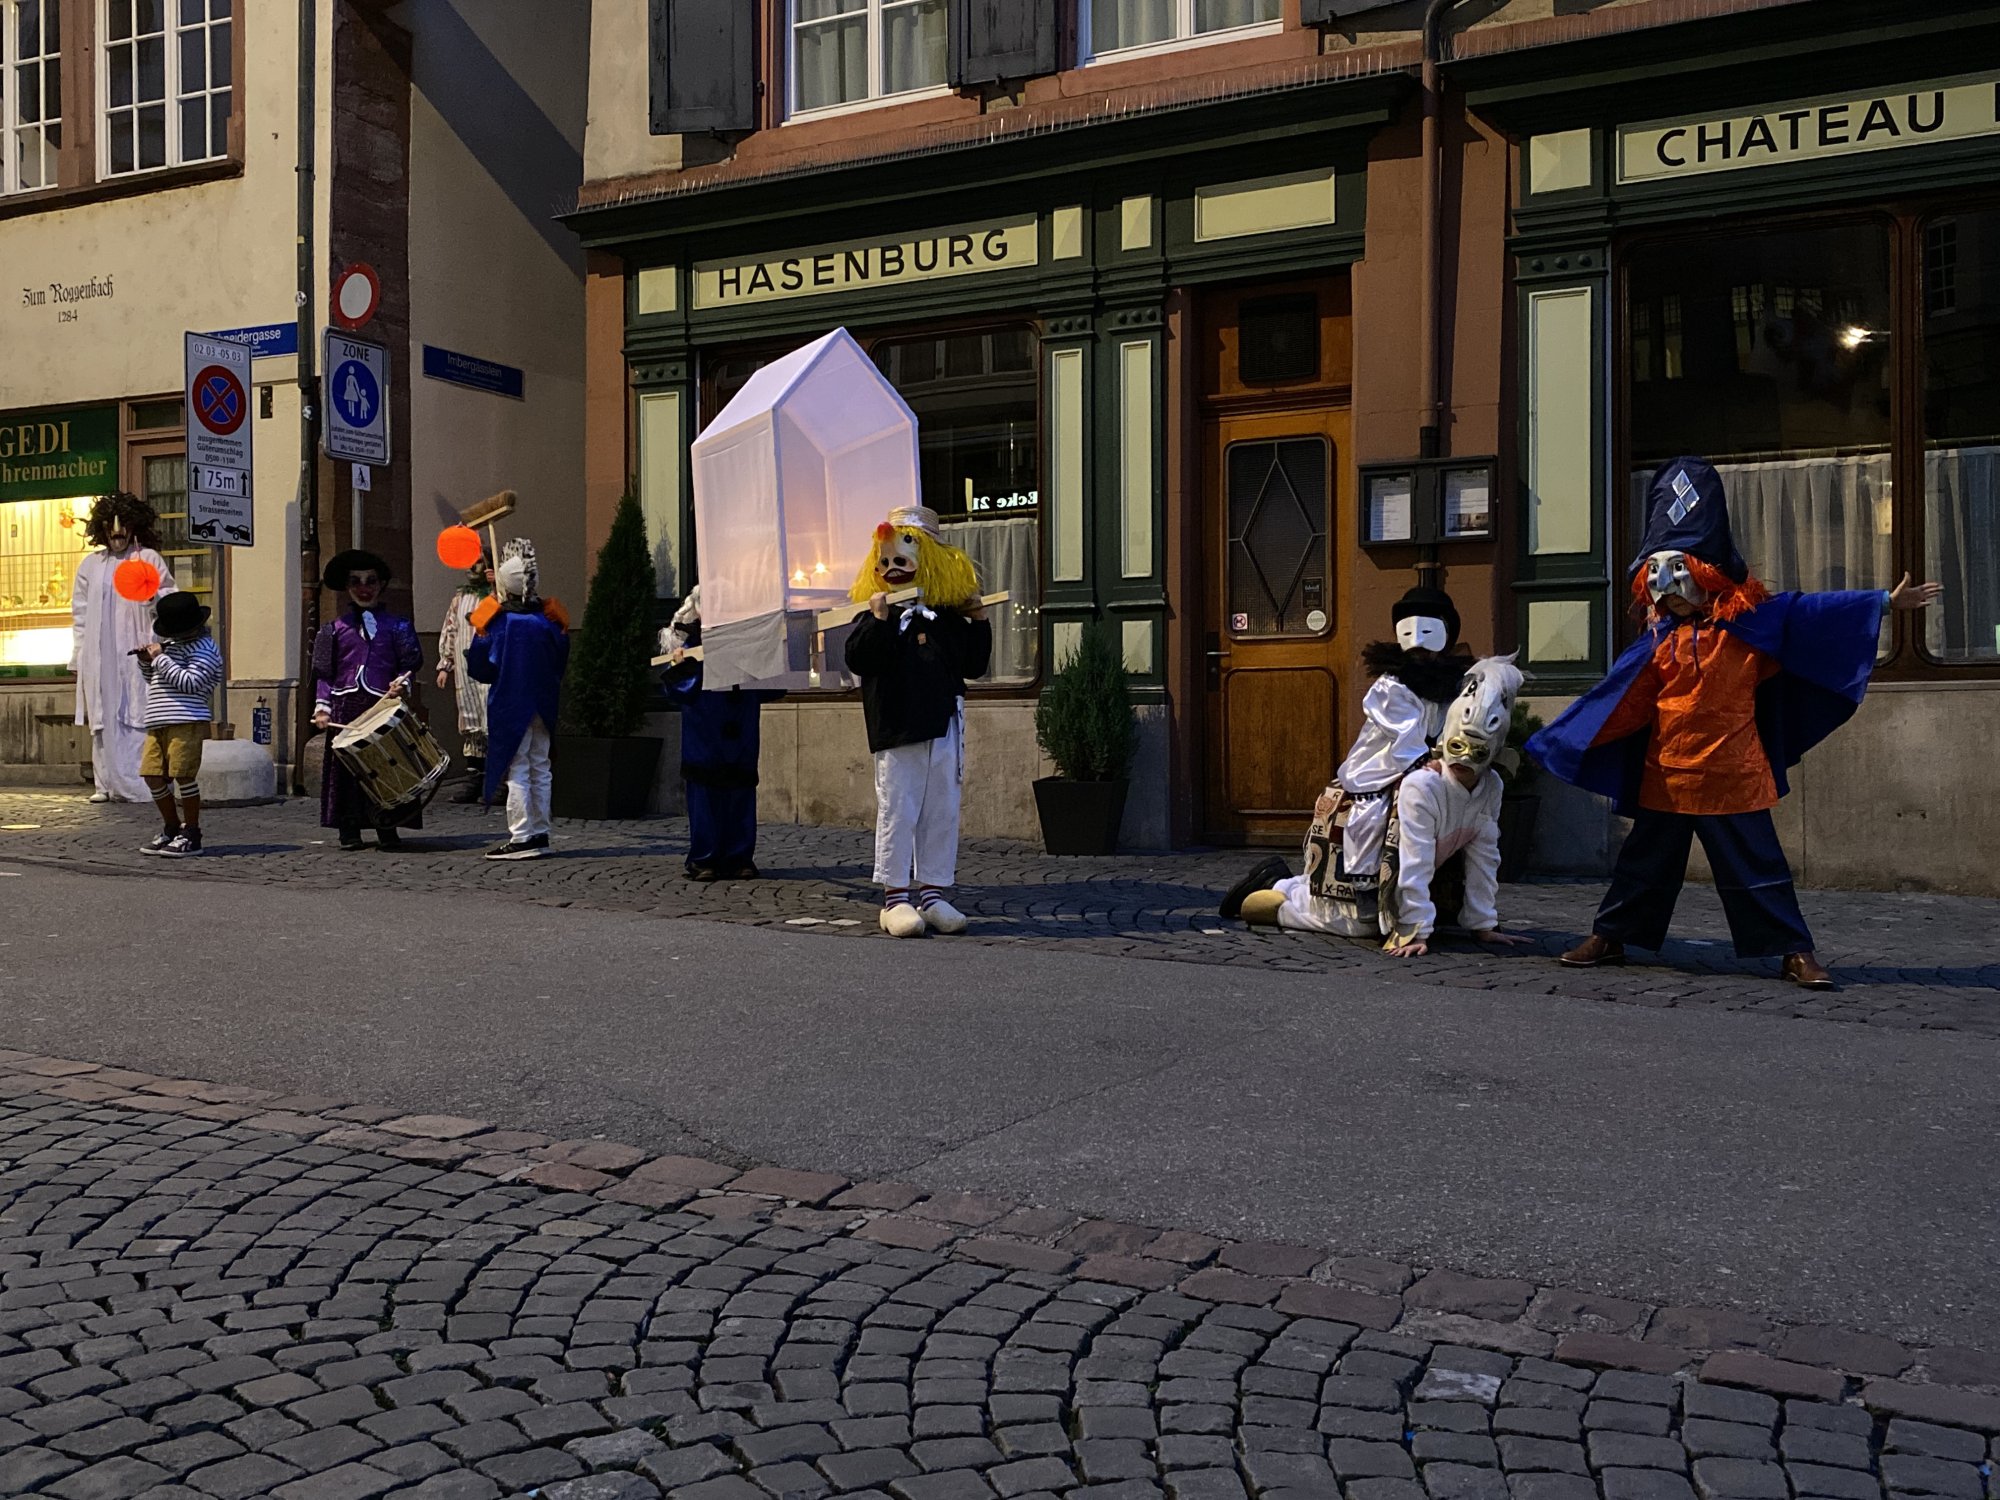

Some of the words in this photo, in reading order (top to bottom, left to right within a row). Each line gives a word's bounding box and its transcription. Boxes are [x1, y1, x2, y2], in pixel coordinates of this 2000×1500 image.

[719, 229, 1008, 298] HASENBURG
[22, 287, 46, 308] Zum
[50, 275, 114, 304] Roggenbach
[57, 309, 78, 323] 1284
[342, 343, 370, 362] ZONE
[197, 435, 242, 448] ausgenommen
[197, 443, 243, 459] Güterumschlag
[0, 455, 107, 484] hrenmacher
[206, 470, 235, 490] 75m
[212, 497, 230, 507] beide
[198, 505, 243, 517] Strassenseiten
